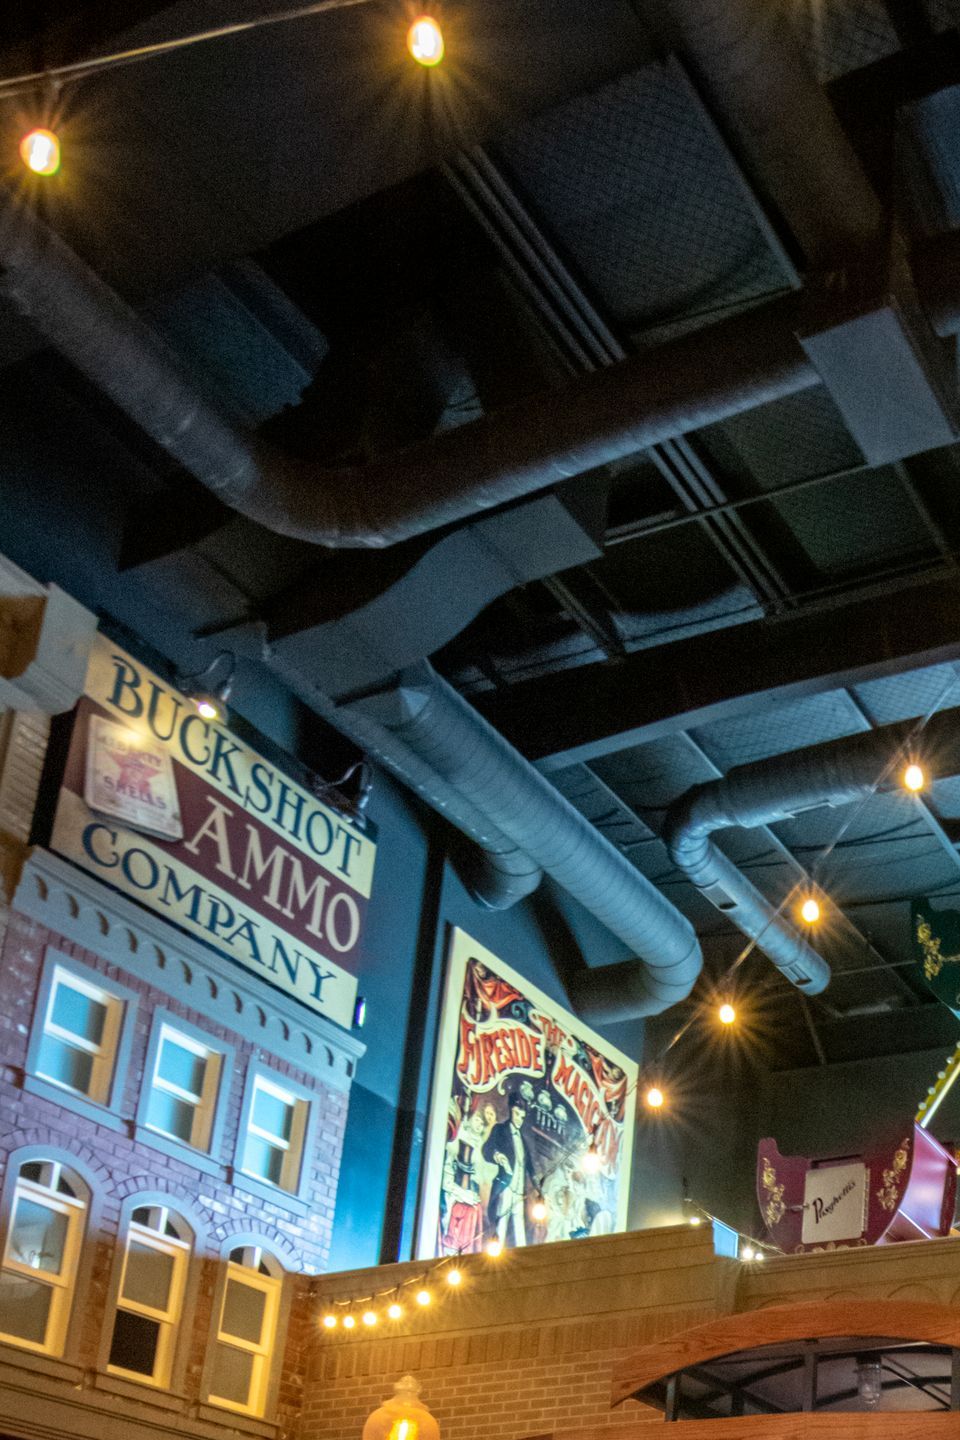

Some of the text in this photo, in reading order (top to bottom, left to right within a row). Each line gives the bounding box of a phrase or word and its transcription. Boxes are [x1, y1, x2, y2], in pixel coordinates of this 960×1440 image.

[106, 655, 362, 877] BUCKSHOT
[81, 822, 337, 1002] COMPANY
[184, 796, 361, 953] AMMO
[457, 1015, 543, 1086] FIRESIDE
